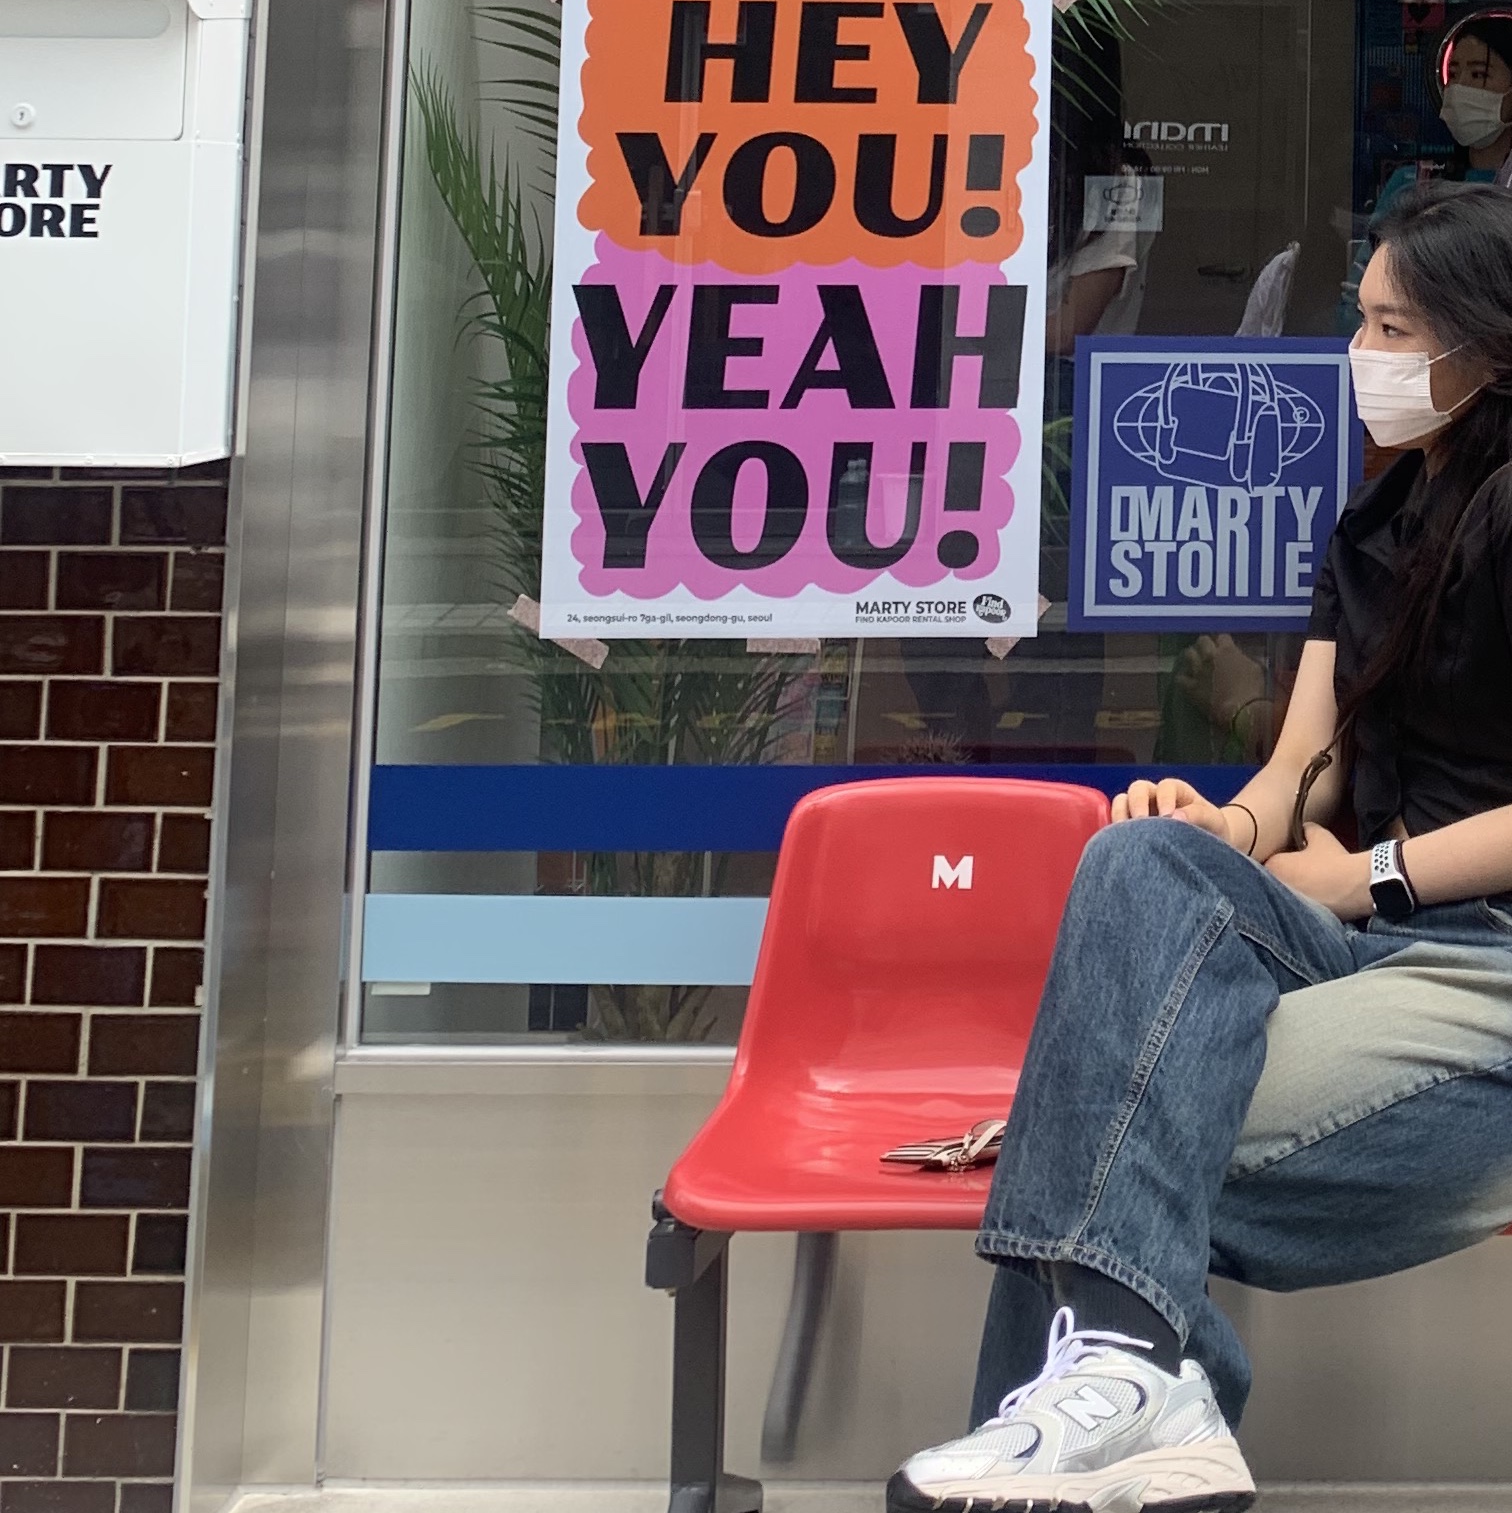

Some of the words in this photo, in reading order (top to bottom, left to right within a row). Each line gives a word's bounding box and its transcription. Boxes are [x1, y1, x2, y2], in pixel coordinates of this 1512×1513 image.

[663, 0, 993, 105] HEY
[615, 130, 1006, 239] YOU!
[571, 283, 1029, 411] YEAH
[579, 439, 988, 571] YOU!
[747, 613, 773, 623] seoul
[855, 601, 912, 615] MARTY
[915, 601, 967, 615] STORE
[931, 854, 975, 890] M
